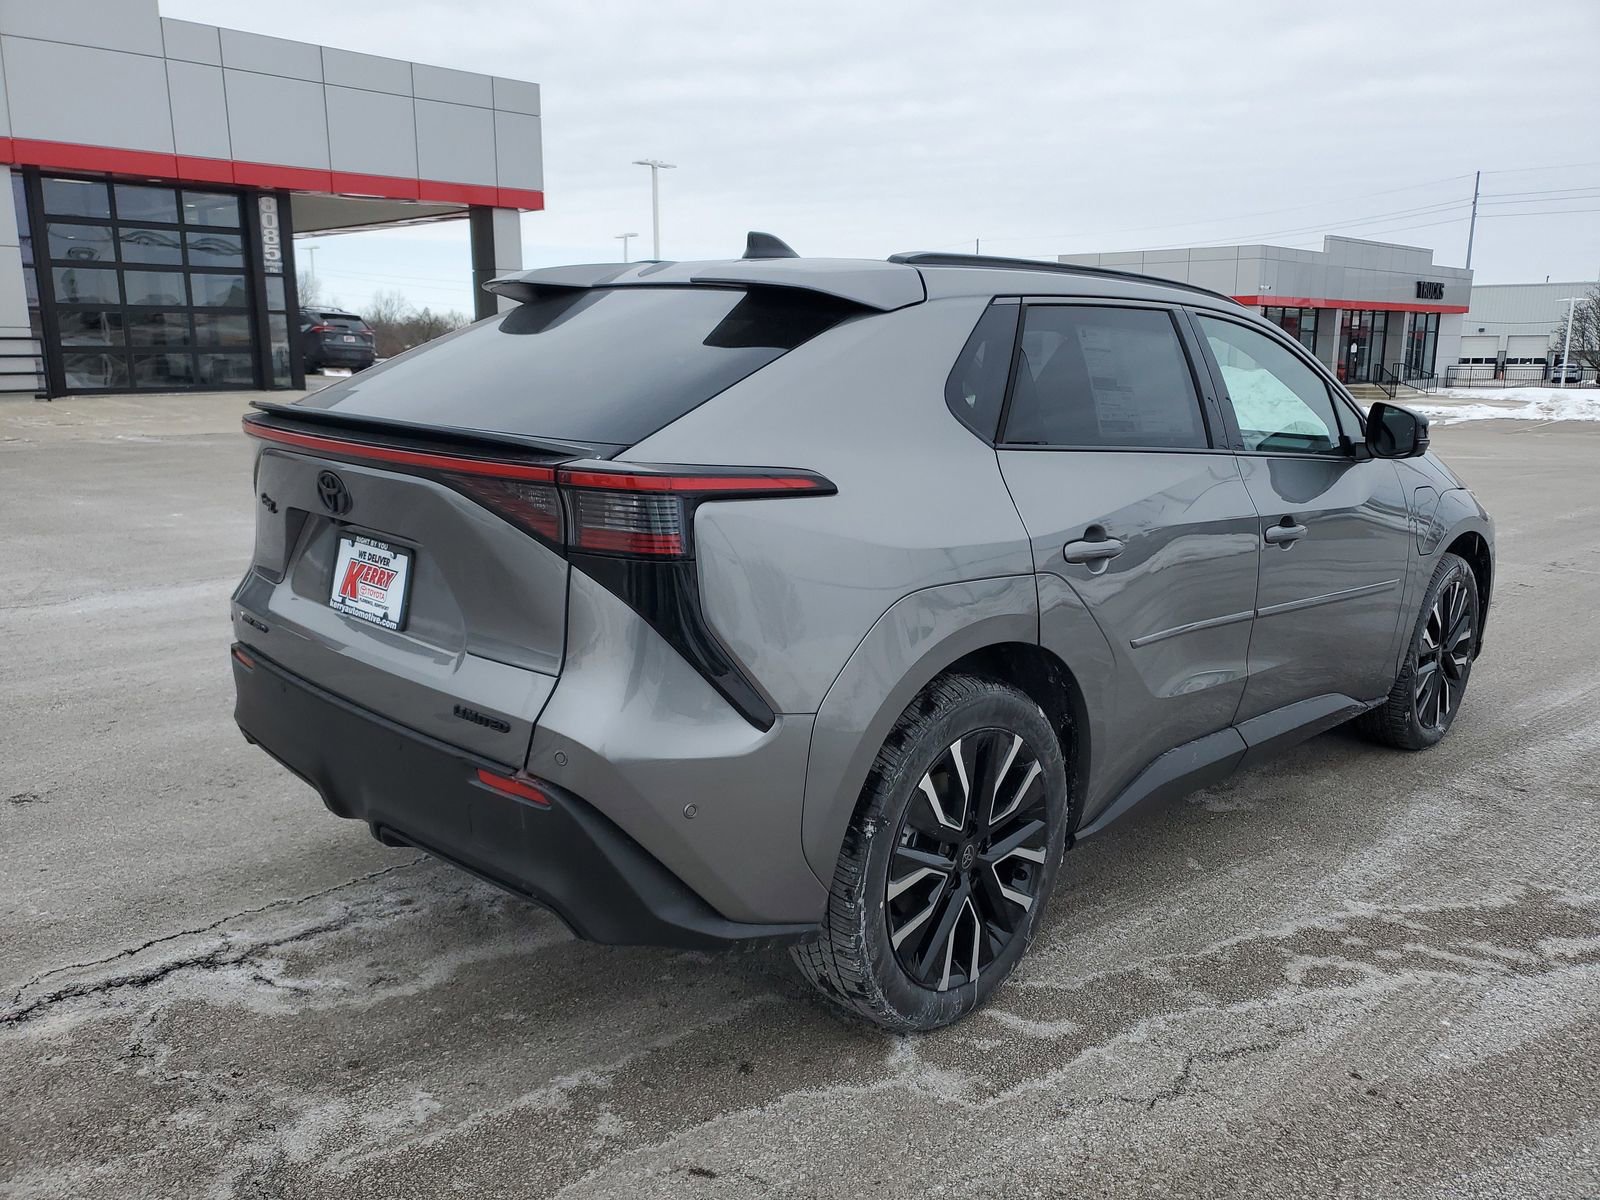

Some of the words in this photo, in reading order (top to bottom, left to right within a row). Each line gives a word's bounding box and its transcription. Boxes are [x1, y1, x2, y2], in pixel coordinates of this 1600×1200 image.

[261, 197, 281, 260] 8085
[1416, 281, 1445, 300] TRUCKS
[378, 541, 389, 550] YOU
[358, 550, 367, 560] WE
[367, 552, 390, 567] DELIVER
[340, 559, 396, 600] KERRY
[367, 588, 385, 599] TOYOTA
[330, 600, 397, 630] kerryautomotive.com
